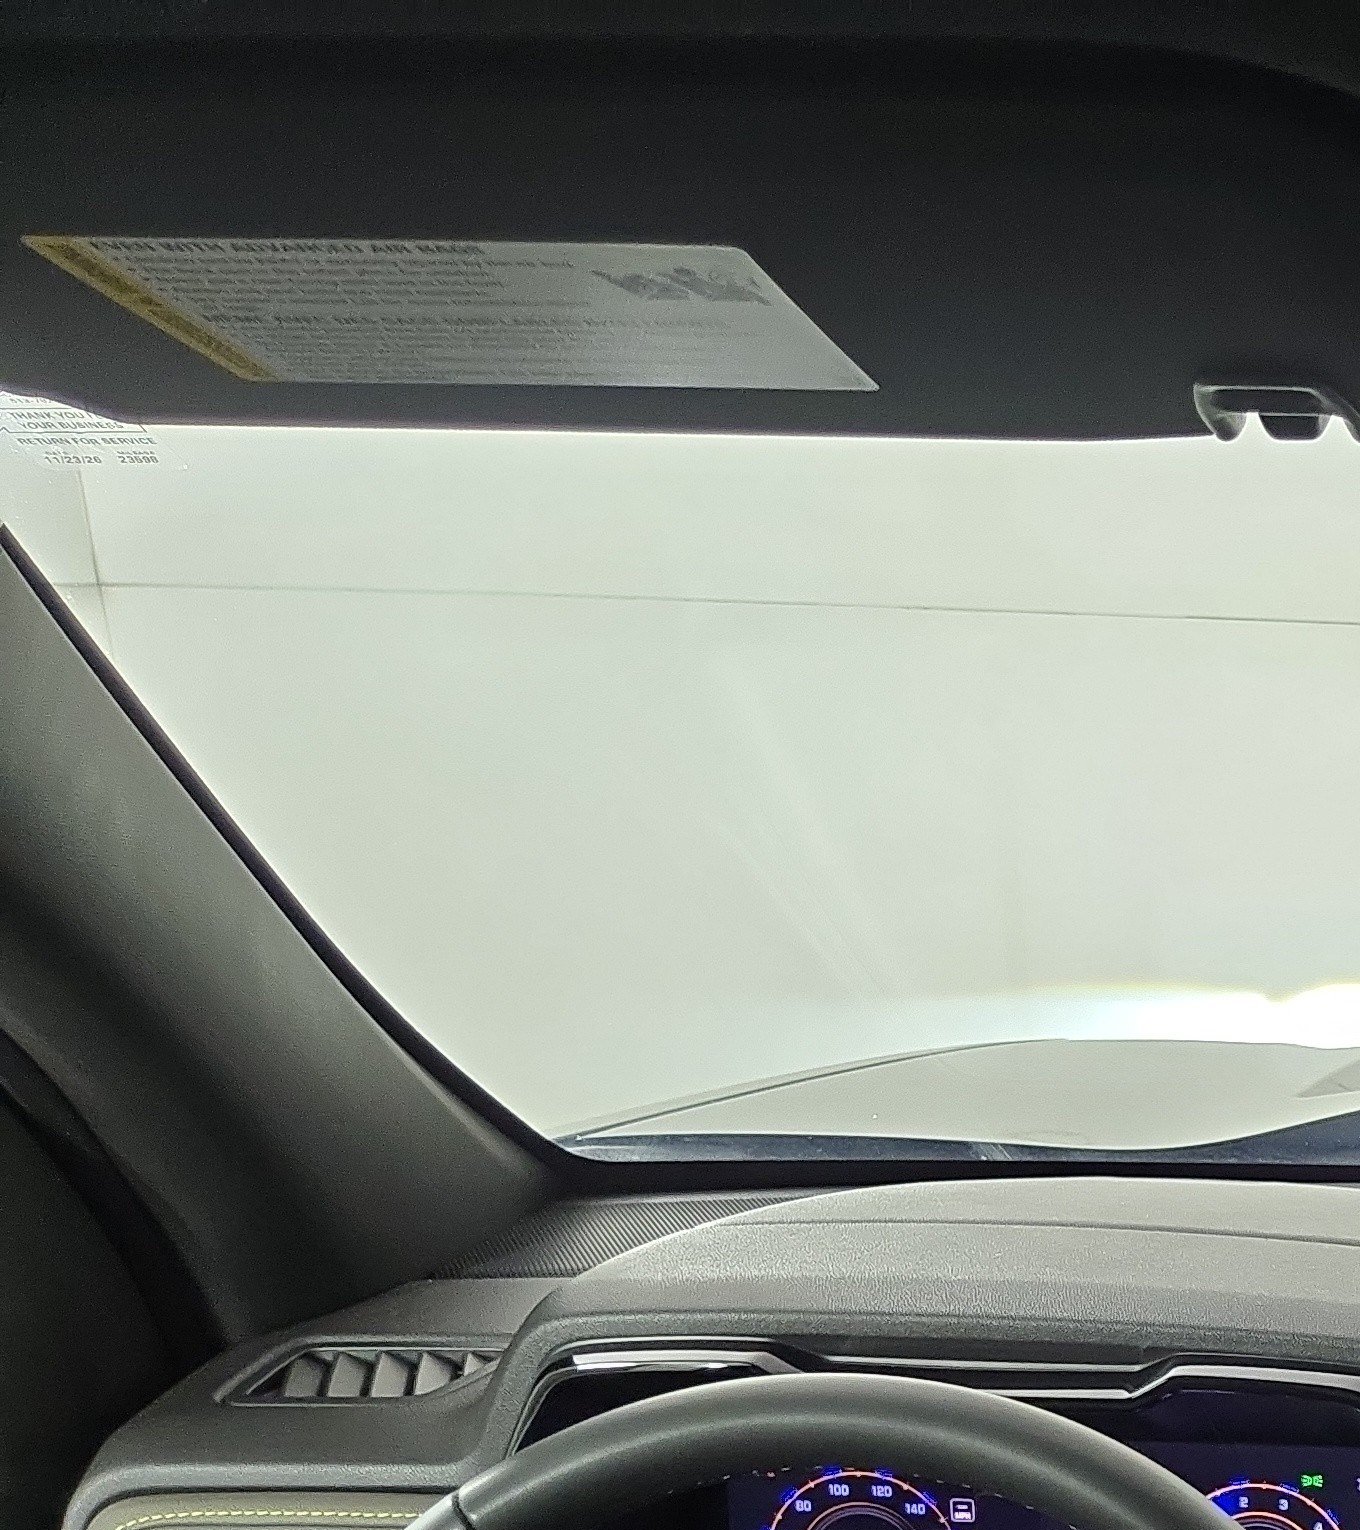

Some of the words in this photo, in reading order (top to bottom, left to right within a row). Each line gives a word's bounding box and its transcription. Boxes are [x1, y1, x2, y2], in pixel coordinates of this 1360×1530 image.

[7, 411, 55, 420] THANK
[54, 411, 85, 419] YOU
[17, 421, 58, 430] YOUR
[57, 421, 124, 430] BUSINESS
[16, 437, 72, 446] RETURN
[72, 437, 101, 446] FOR
[101, 437, 158, 446] SERVICE
[828, 1484, 850, 1497] 100
[871, 1484, 893, 1497] 120
[795, 1500, 812, 1512] 80
[1239, 1496, 1249, 1508] 2
[1279, 1499, 1289, 1510] 3
[905, 1503, 926, 1515] 140
